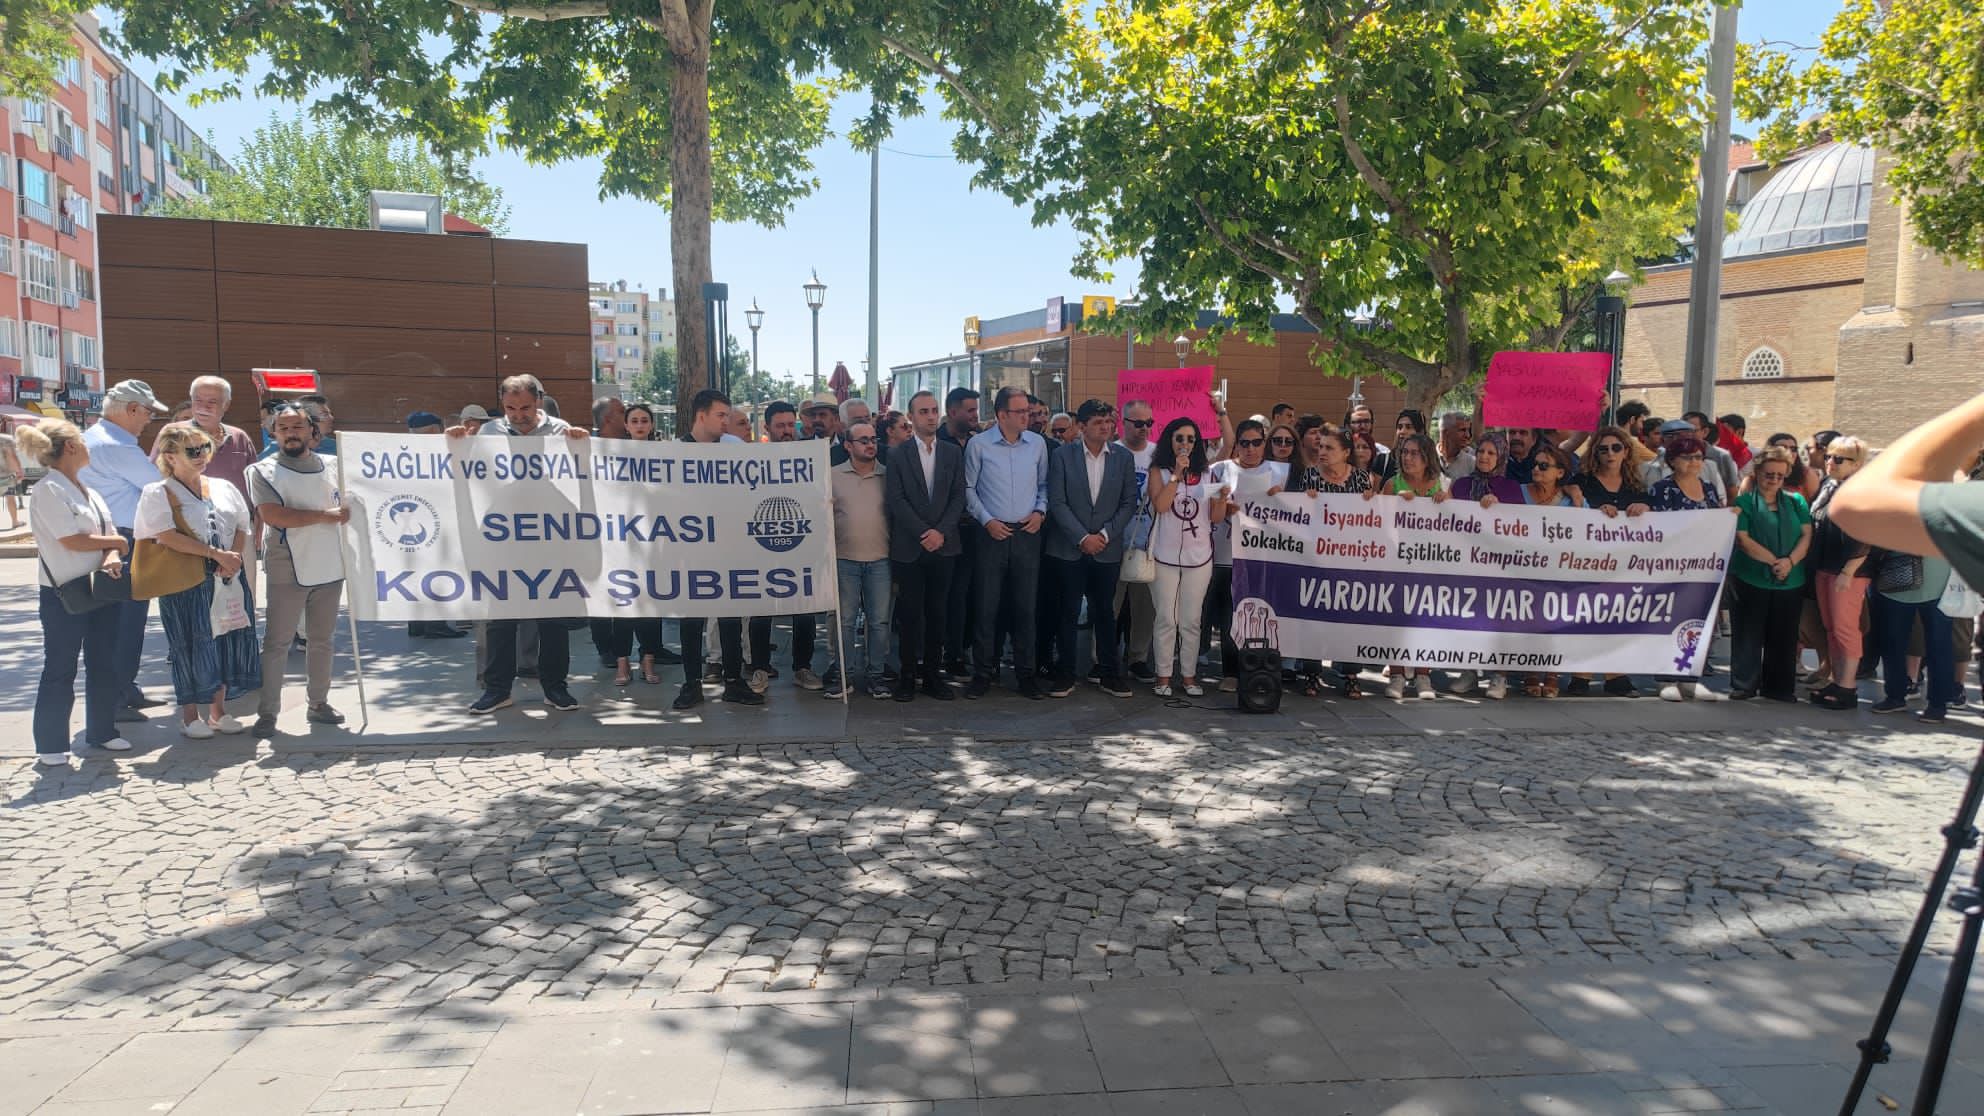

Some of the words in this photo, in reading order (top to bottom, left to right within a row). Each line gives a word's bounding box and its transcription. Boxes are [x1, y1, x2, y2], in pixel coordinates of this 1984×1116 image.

[361, 444, 454, 480] SAĞLIK
[461, 459, 487, 480] ve
[495, 454, 588, 480] SOSYAL
[747, 519, 812, 537] KESK
[1244, 502, 1311, 525] Yaşamda
[1323, 503, 1382, 529] İsyanda
[1394, 511, 1482, 534] Mücadelede
[1494, 518, 1529, 537] Evde
[1542, 516, 1573, 543] İşte
[1586, 523, 1664, 543] Fabrikada
[768, 537, 792, 547] 1995
[1241, 530, 1304, 554] Sokakta
[1316, 537, 1386, 562] Direnişte
[1398, 542, 1461, 564] Eşitlikte
[1470, 546, 1549, 571] Kampüste
[1558, 551, 1617, 571] Plazada
[1628, 552, 1725, 575] Dayanışmada
[375, 568, 591, 602] KONYA
[1299, 577, 1395, 614] VARDIK
[1403, 583, 1478, 619] VARIZ
[1486, 589, 1534, 622] VAR
[1542, 586, 1675, 624] OLACAĞIZ!
[1356, 645, 1411, 662] KONYA
[1415, 648, 1464, 664] KADIN
[1468, 651, 1563, 667] PLATFORMU
